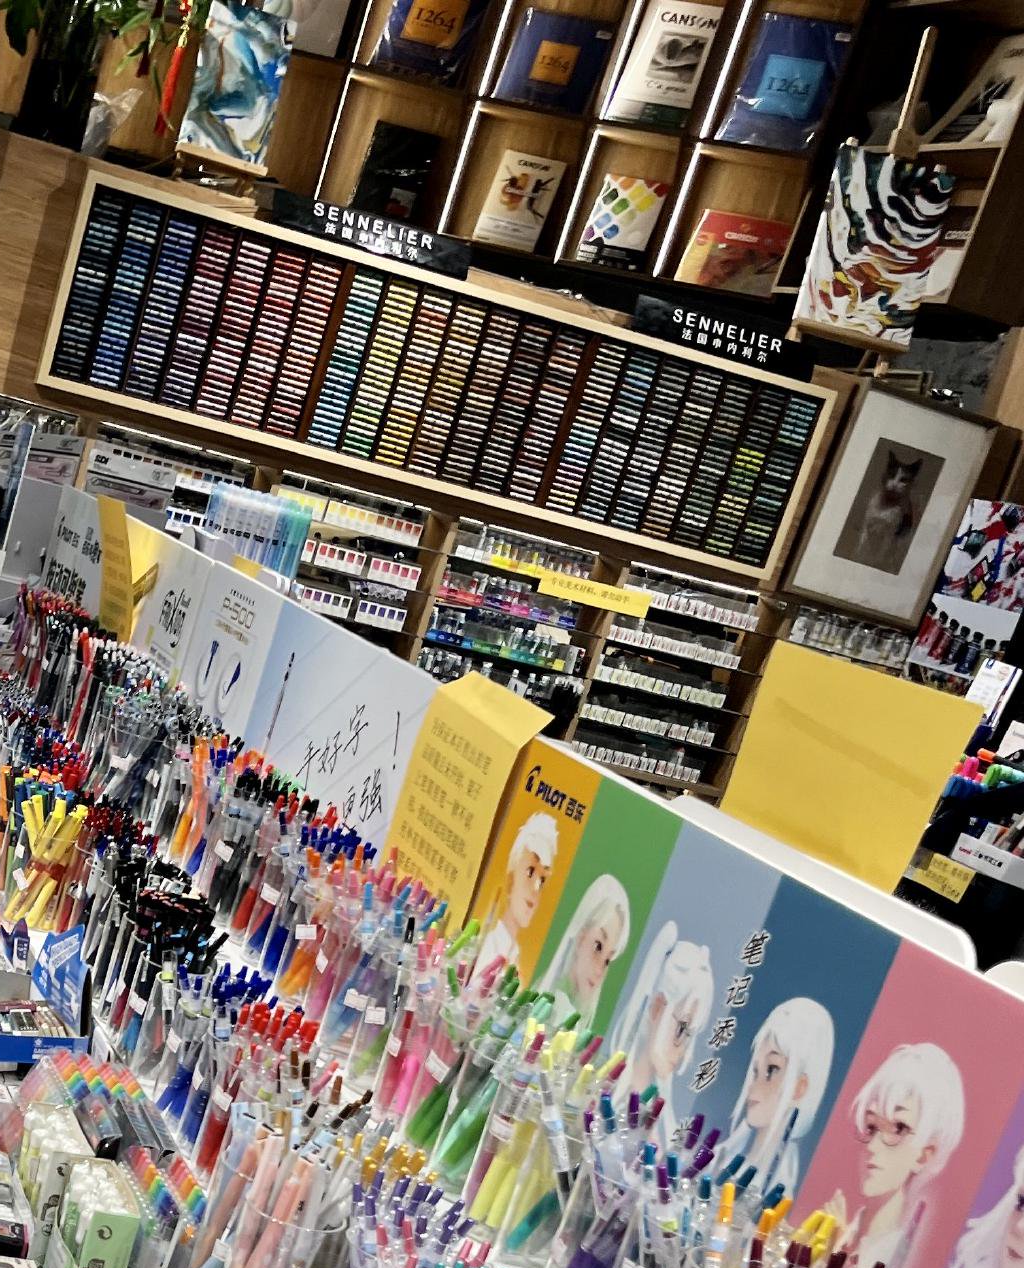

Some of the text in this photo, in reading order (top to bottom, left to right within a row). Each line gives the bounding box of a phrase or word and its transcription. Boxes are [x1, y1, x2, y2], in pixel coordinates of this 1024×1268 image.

[411, 8, 456, 33] 1264
[661, 12, 720, 29] CANSON
[539, 54, 571, 73] 1264
[313, 203, 433, 250] SENNELIER
[673, 308, 782, 353] SENNELIER
[535, 780, 567, 811] PILOT
[689, 928, 772, 1093] 笔记添彩
